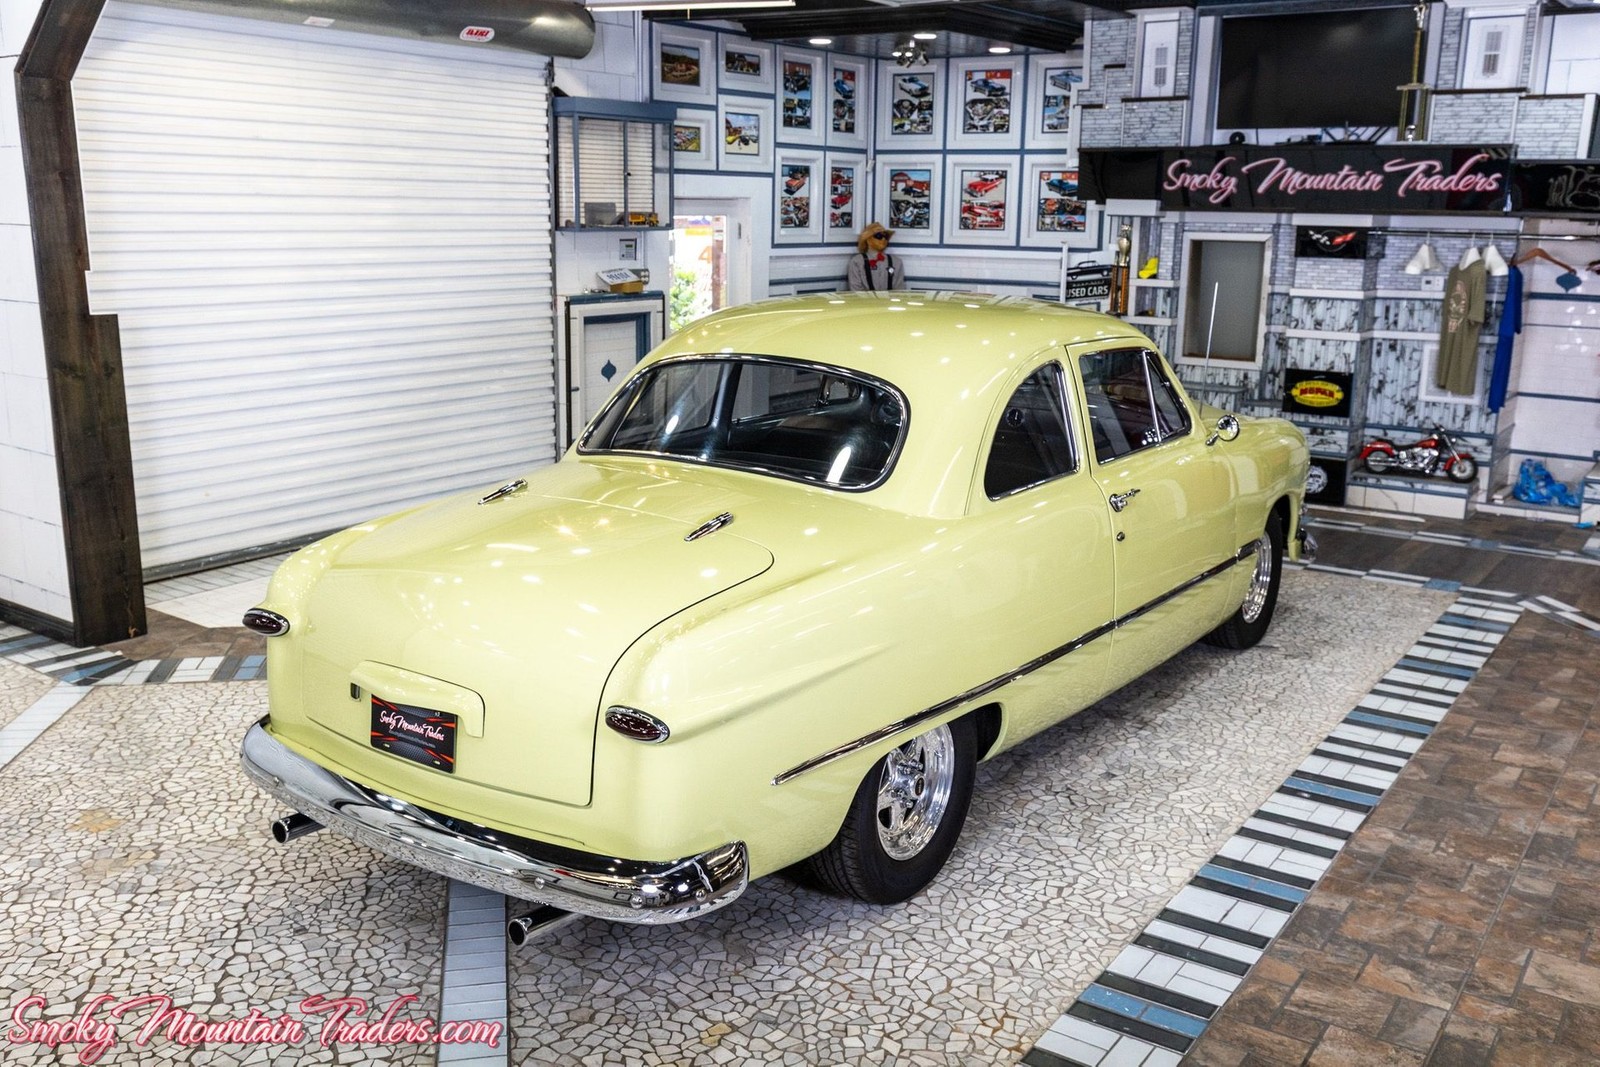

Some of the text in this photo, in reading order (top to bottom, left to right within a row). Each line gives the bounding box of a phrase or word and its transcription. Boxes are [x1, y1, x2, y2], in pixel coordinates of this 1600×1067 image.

[1163, 154, 1503, 203] Smoky Mountain Traders
[1087, 285, 1109, 297] CARS
[380, 710, 396, 729] Smoky
[394, 715, 425, 735] Mountain
[422, 723, 445, 741] Traders
